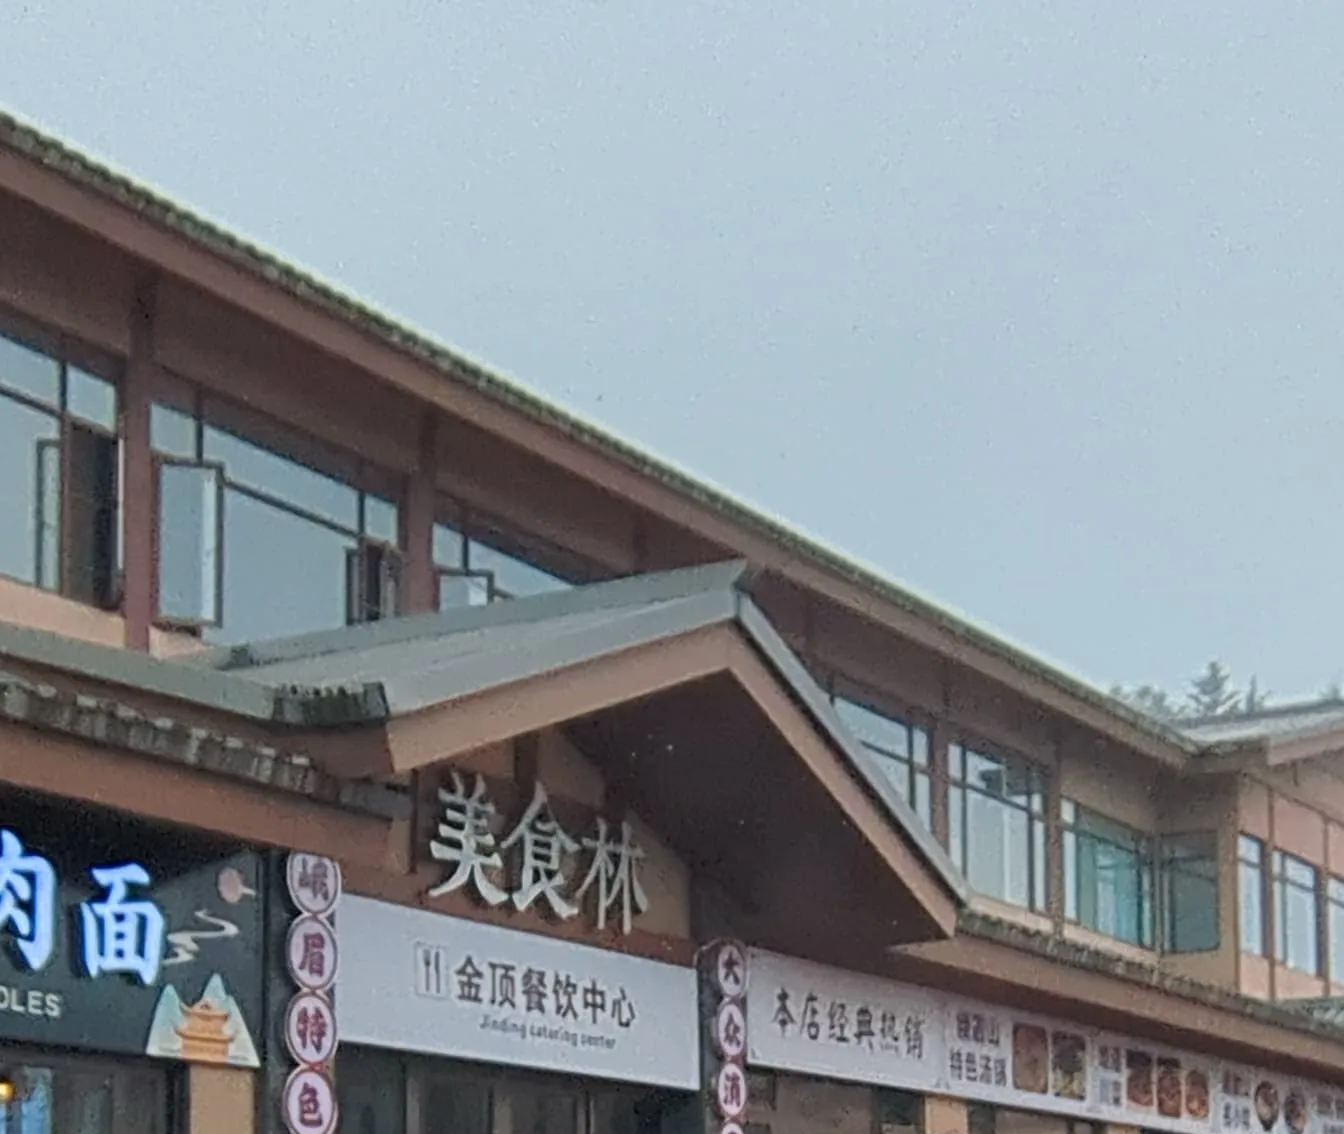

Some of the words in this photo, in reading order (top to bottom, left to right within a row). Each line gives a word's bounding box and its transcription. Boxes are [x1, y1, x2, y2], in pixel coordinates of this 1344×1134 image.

[428, 770, 649, 935] 美食林
[455, 954, 636, 1028] 金顶餐饮中心
